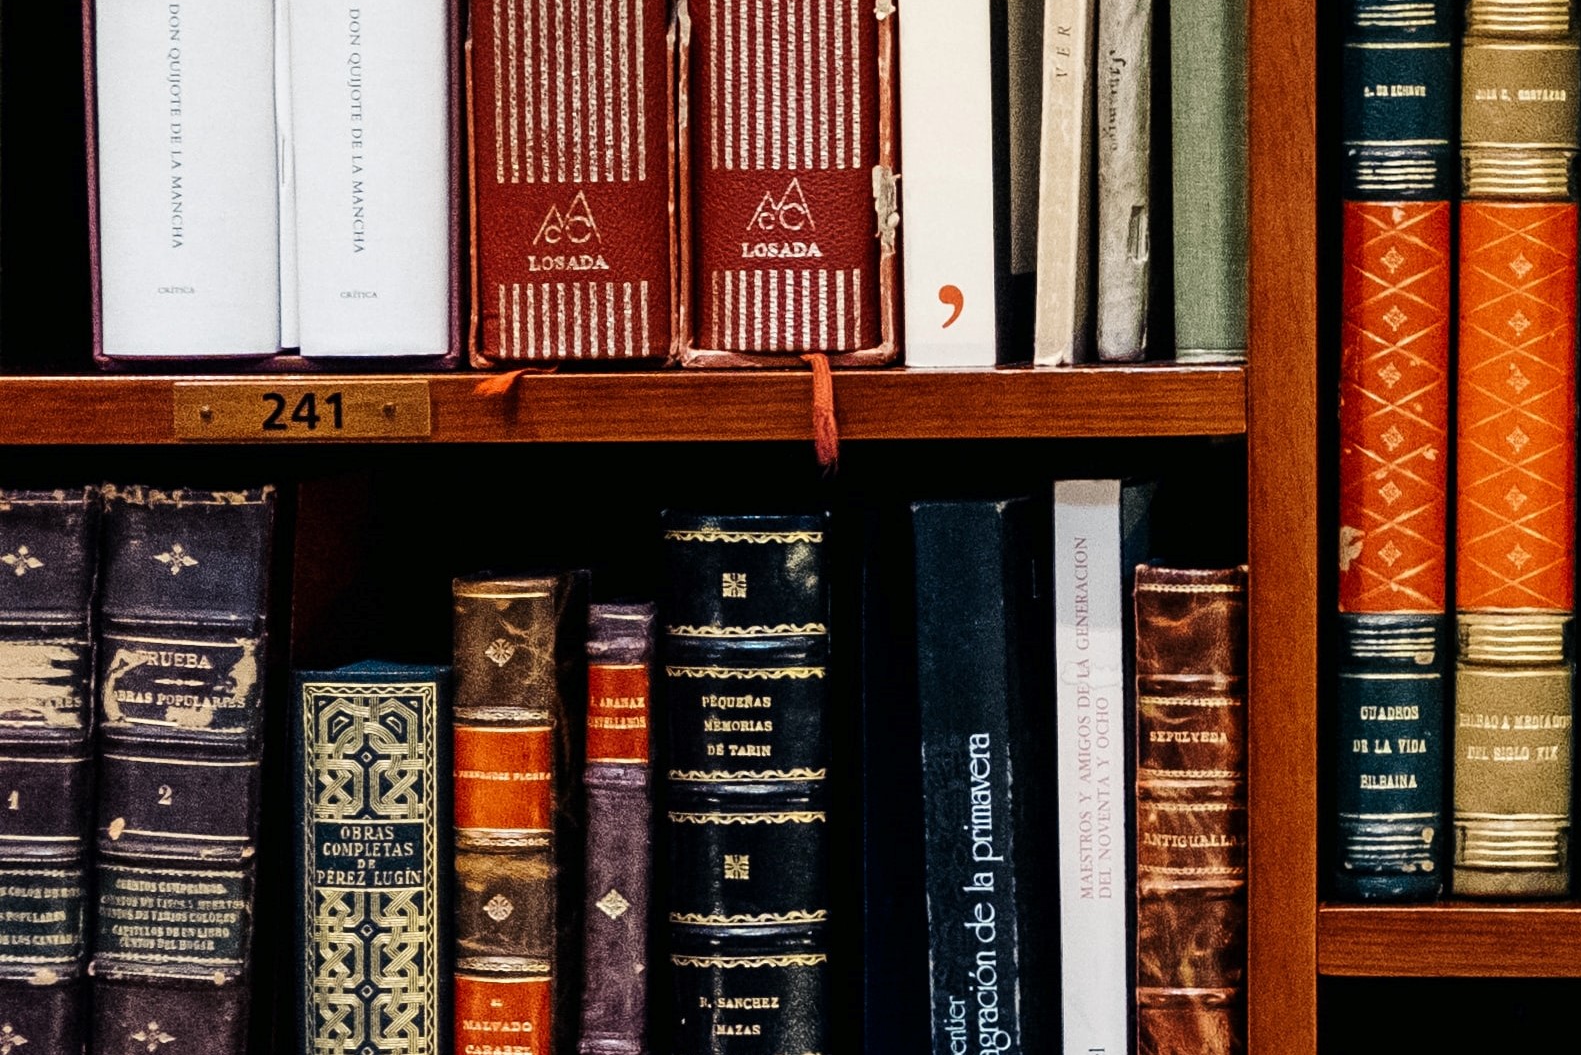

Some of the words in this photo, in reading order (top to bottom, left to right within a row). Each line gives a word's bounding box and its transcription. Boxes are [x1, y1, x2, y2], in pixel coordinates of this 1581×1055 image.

[168, 3, 181, 42] DON
[349, 7, 362, 47] DON
[1055, 24, 1072, 79] VER
[168, 47, 183, 117] QUIJOTE
[347, 52, 363, 122] QUIJOTE
[170, 123, 182, 145] DE
[351, 127, 364, 150] DE
[170, 150, 183, 172] LA
[351, 154, 364, 176] LA
[171, 176, 185, 249] MANCHA
[352, 180, 365, 255] MANCHA
[741, 241, 824, 260] LOSADA
[527, 254, 609, 273] LOSADA
[261, 391, 345, 432] 241
[1073, 536, 1090, 651] GENERACION
[1076, 659, 1090, 679] LA
[701, 693, 772, 709] PEQUEÑAS
[1076, 685, 1090, 708] DE
[1095, 696, 1111, 749] OCHO
[1360, 705, 1419, 721] CUADROS
[703, 719, 774, 733] MEMORIAS
[1149, 730, 1228, 744] SEPULVEDA
[1077, 715, 1093, 783] AMIGOS
[1096, 756, 1109, 768] Y
[158, 785, 174, 806] 2
[1078, 793, 1092, 804] Y
[1096, 775, 1112, 865] NOVENTA
[340, 824, 396, 841] OBRAS
[321, 840, 415, 858] COMPLETAS
[1078, 812, 1095, 900] MAESTROS
[356, 859, 377, 870] DE
[316, 865, 368, 887] PÉREZ
[375, 867, 423, 887] LUGÍN
[1097, 867, 1112, 899] DEL
